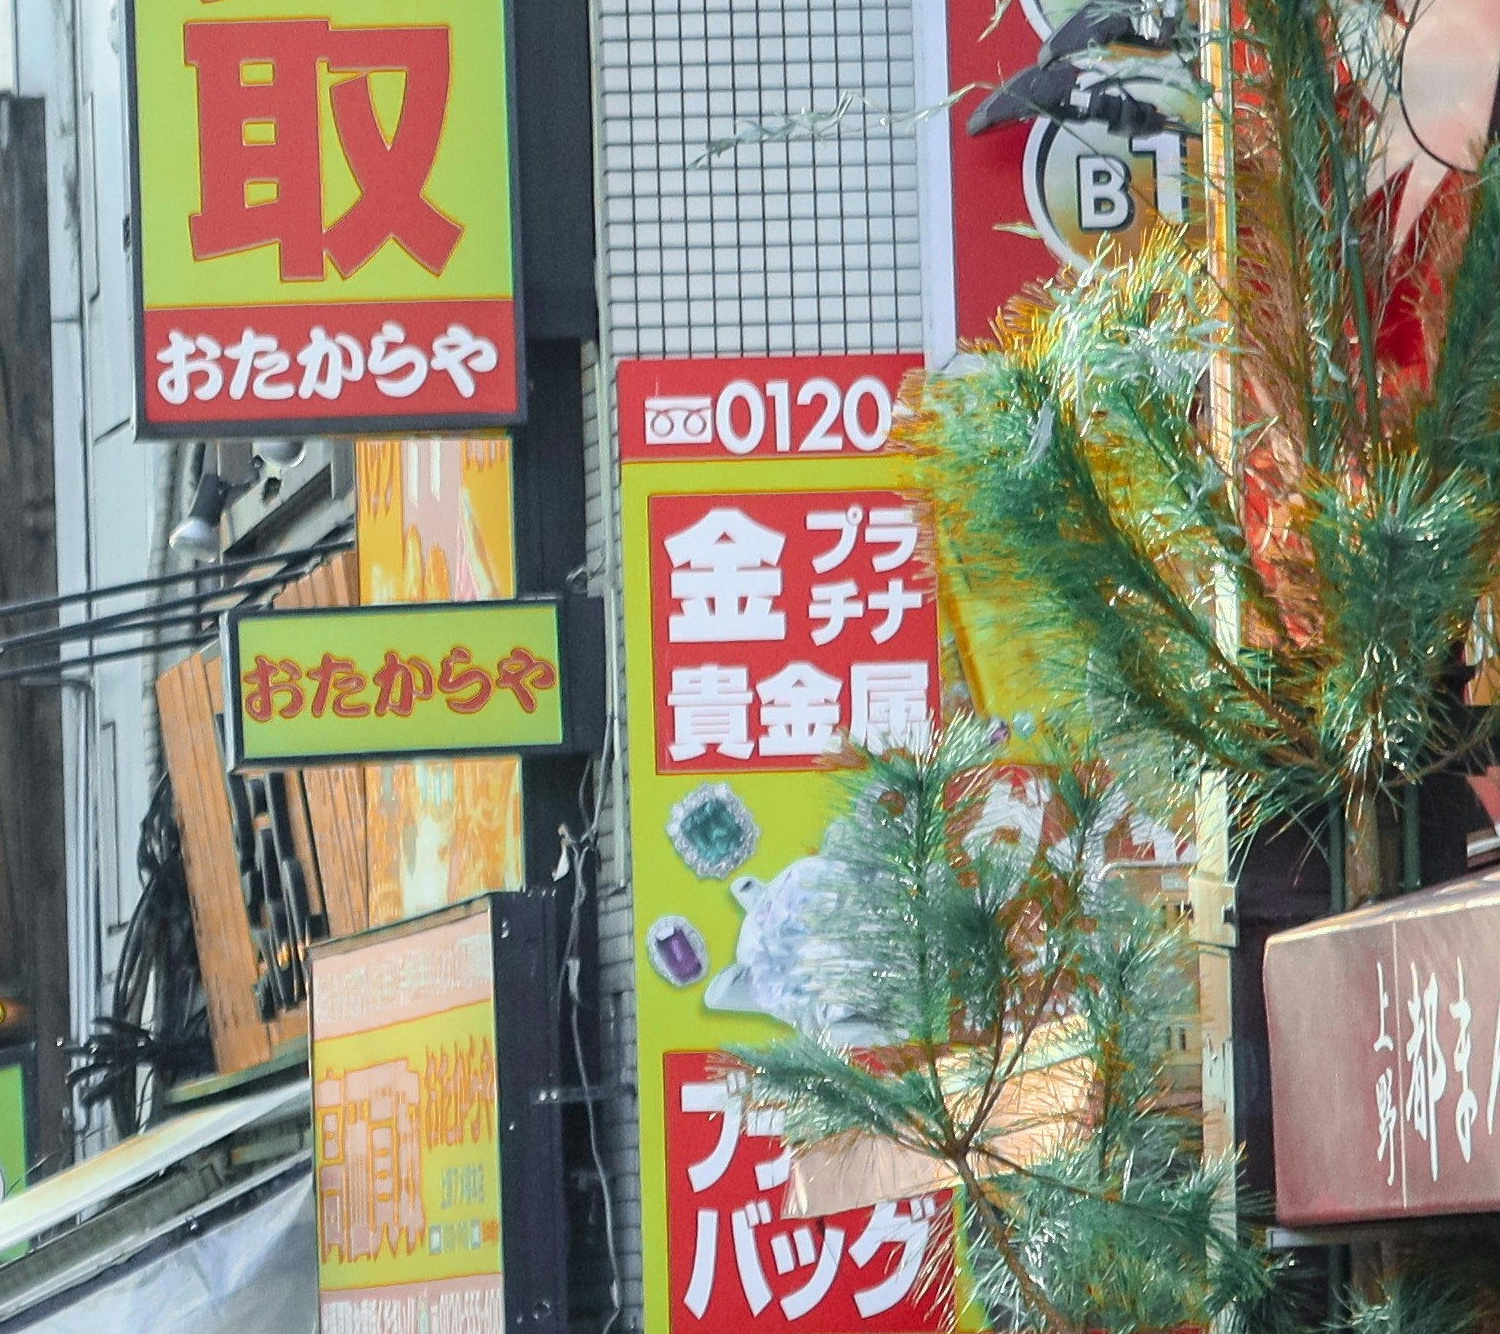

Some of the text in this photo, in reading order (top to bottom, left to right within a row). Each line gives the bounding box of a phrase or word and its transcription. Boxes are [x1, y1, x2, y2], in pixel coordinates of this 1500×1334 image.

[155, 323, 498, 404] おたからや
[714, 374, 894, 455] 0120
[664, 506, 788, 646] 金
[804, 504, 922, 575] プラ
[805, 579, 928, 646] チナ
[240, 645, 559, 725] おたからや
[666, 663, 933, 762] 貴金属
[683, 1197, 935, 1323] バッグ
